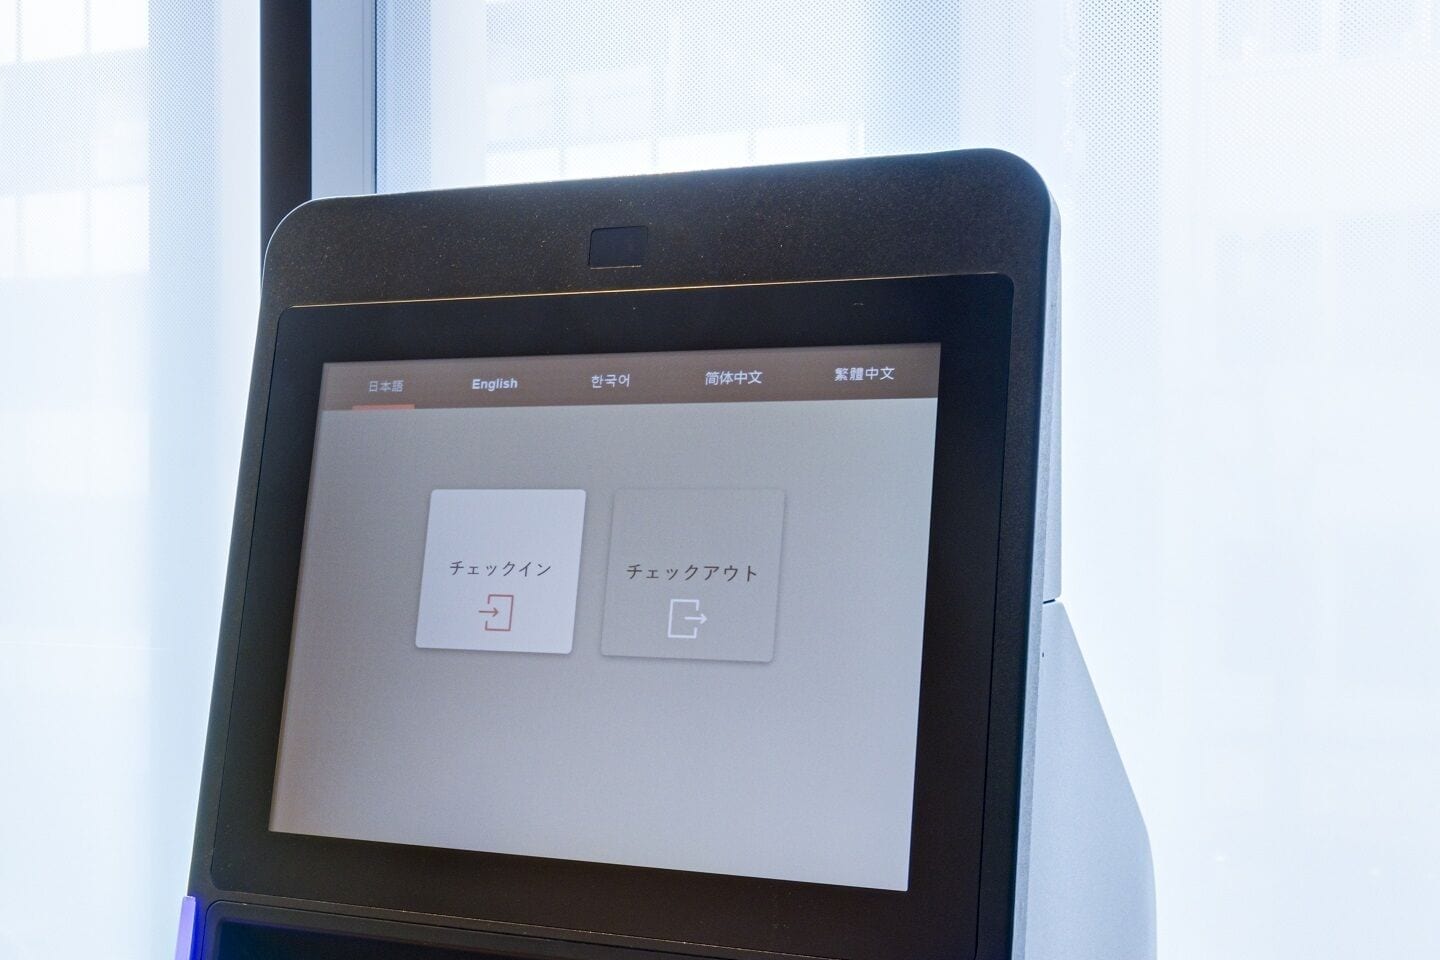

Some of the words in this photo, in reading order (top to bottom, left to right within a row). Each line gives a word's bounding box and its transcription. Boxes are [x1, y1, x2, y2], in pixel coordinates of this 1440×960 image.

[590, 373, 631, 389] 한국어
[704, 369, 763, 386] 简体中文
[833, 365, 896, 382] 繁體中文
[367, 379, 405, 393] 日本語
[471, 378, 518, 392] English
[449, 560, 552, 577] チェックイン
[626, 563, 758, 582] チェックアウト
